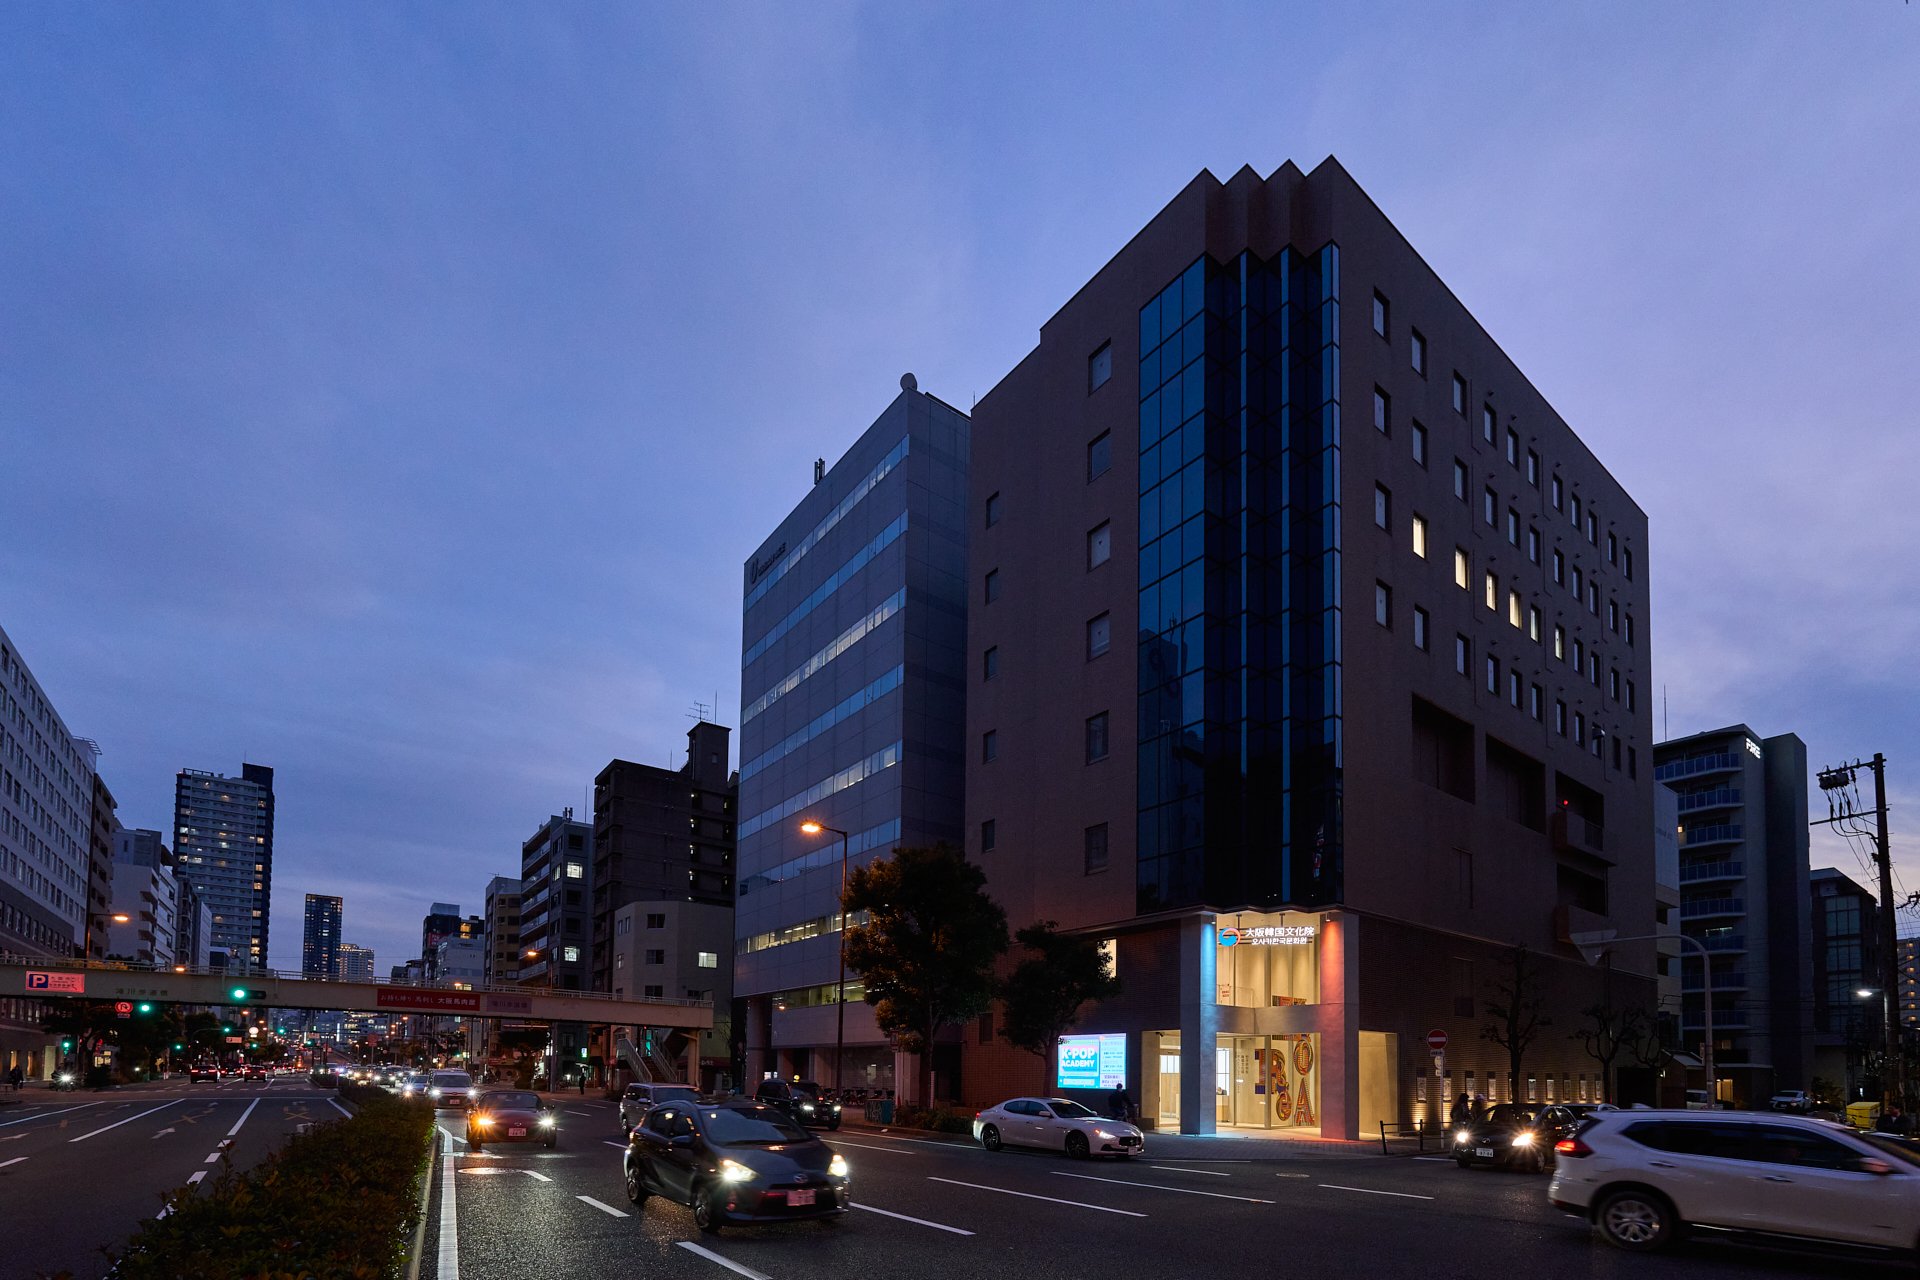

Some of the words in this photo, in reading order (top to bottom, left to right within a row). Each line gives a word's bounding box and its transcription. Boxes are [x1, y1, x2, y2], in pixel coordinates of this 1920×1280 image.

[1245, 926, 1315, 937] 大阪韓国文化院
[1251, 937, 1308, 945] 오사카한국문화원
